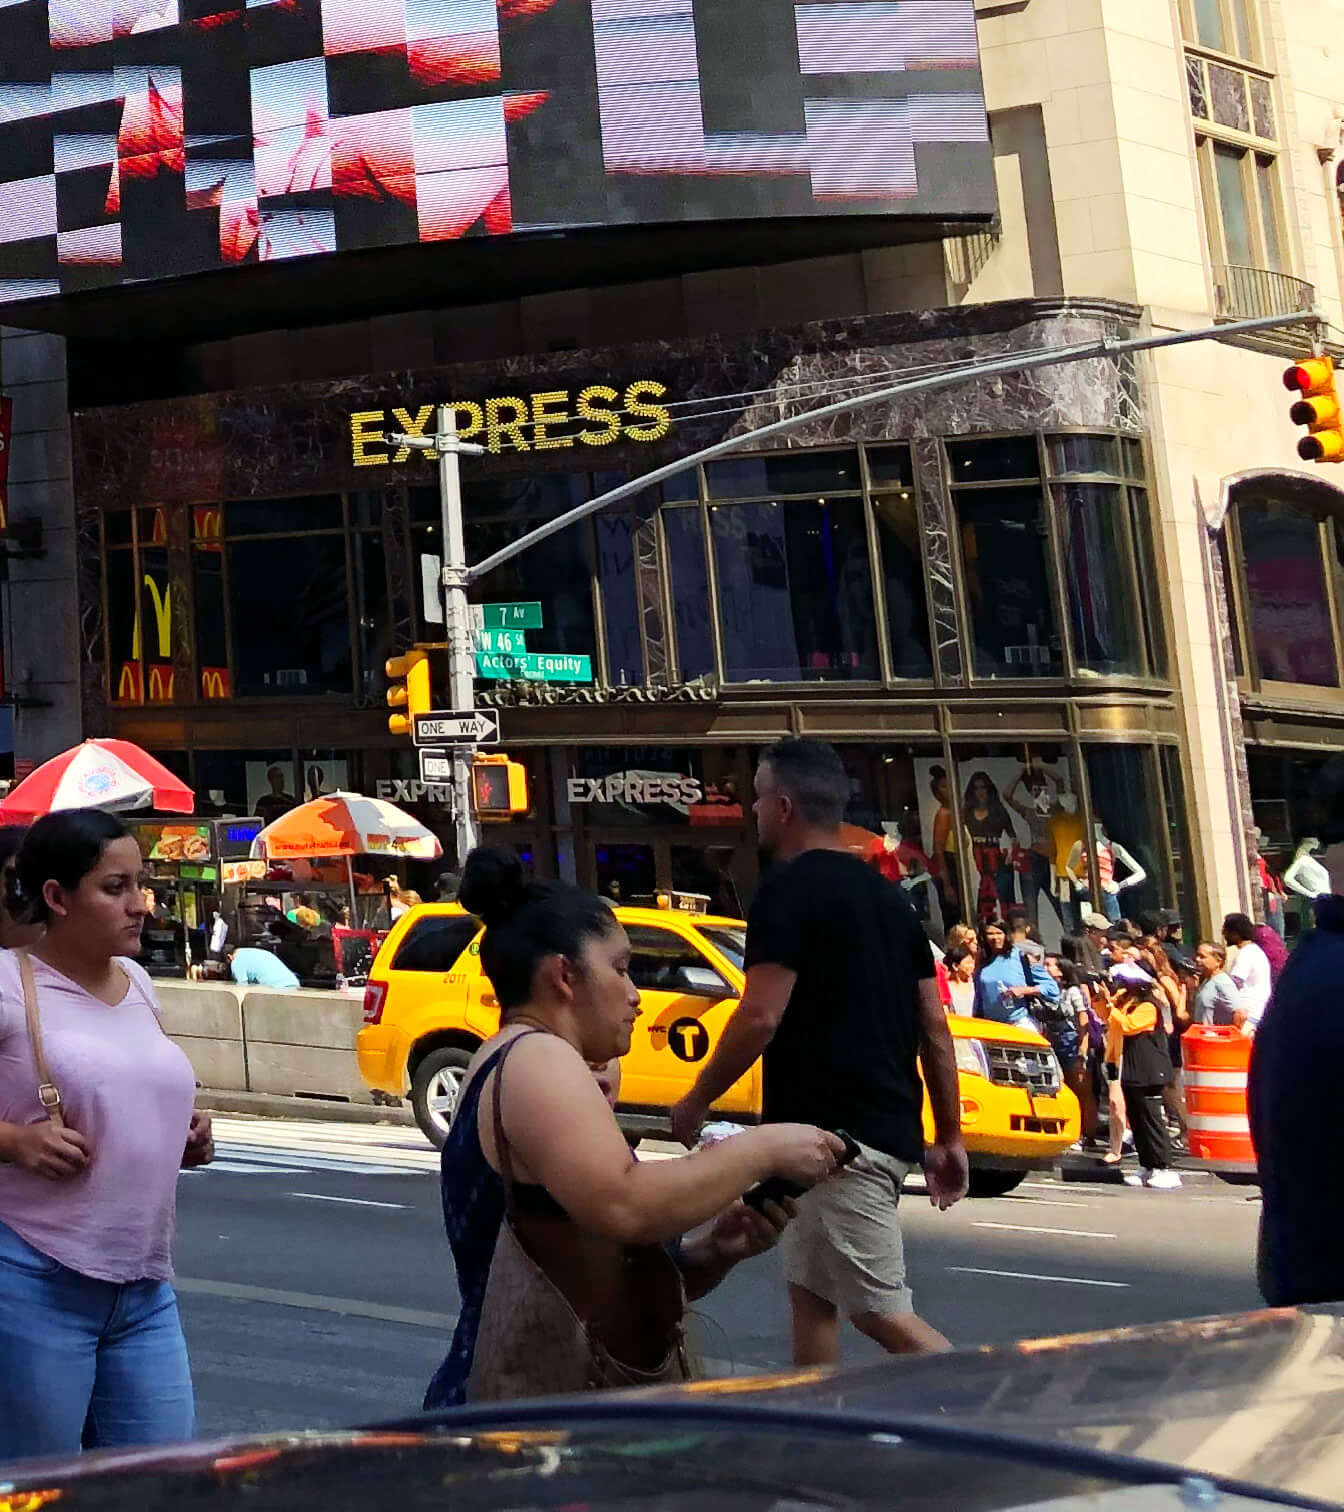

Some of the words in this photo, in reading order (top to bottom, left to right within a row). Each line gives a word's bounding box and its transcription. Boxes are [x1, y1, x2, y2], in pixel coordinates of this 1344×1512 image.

[350, 380, 672, 466] EXPRESS
[499, 607, 507, 625] 7
[481, 631, 492, 651] W
[497, 633, 511, 652] 46
[482, 655, 531, 669] Actors'
[538, 656, 581, 673] Equity
[421, 722, 445, 735] ONE
[459, 721, 485, 734] WAY
[567, 778, 702, 804] EXPRESS
